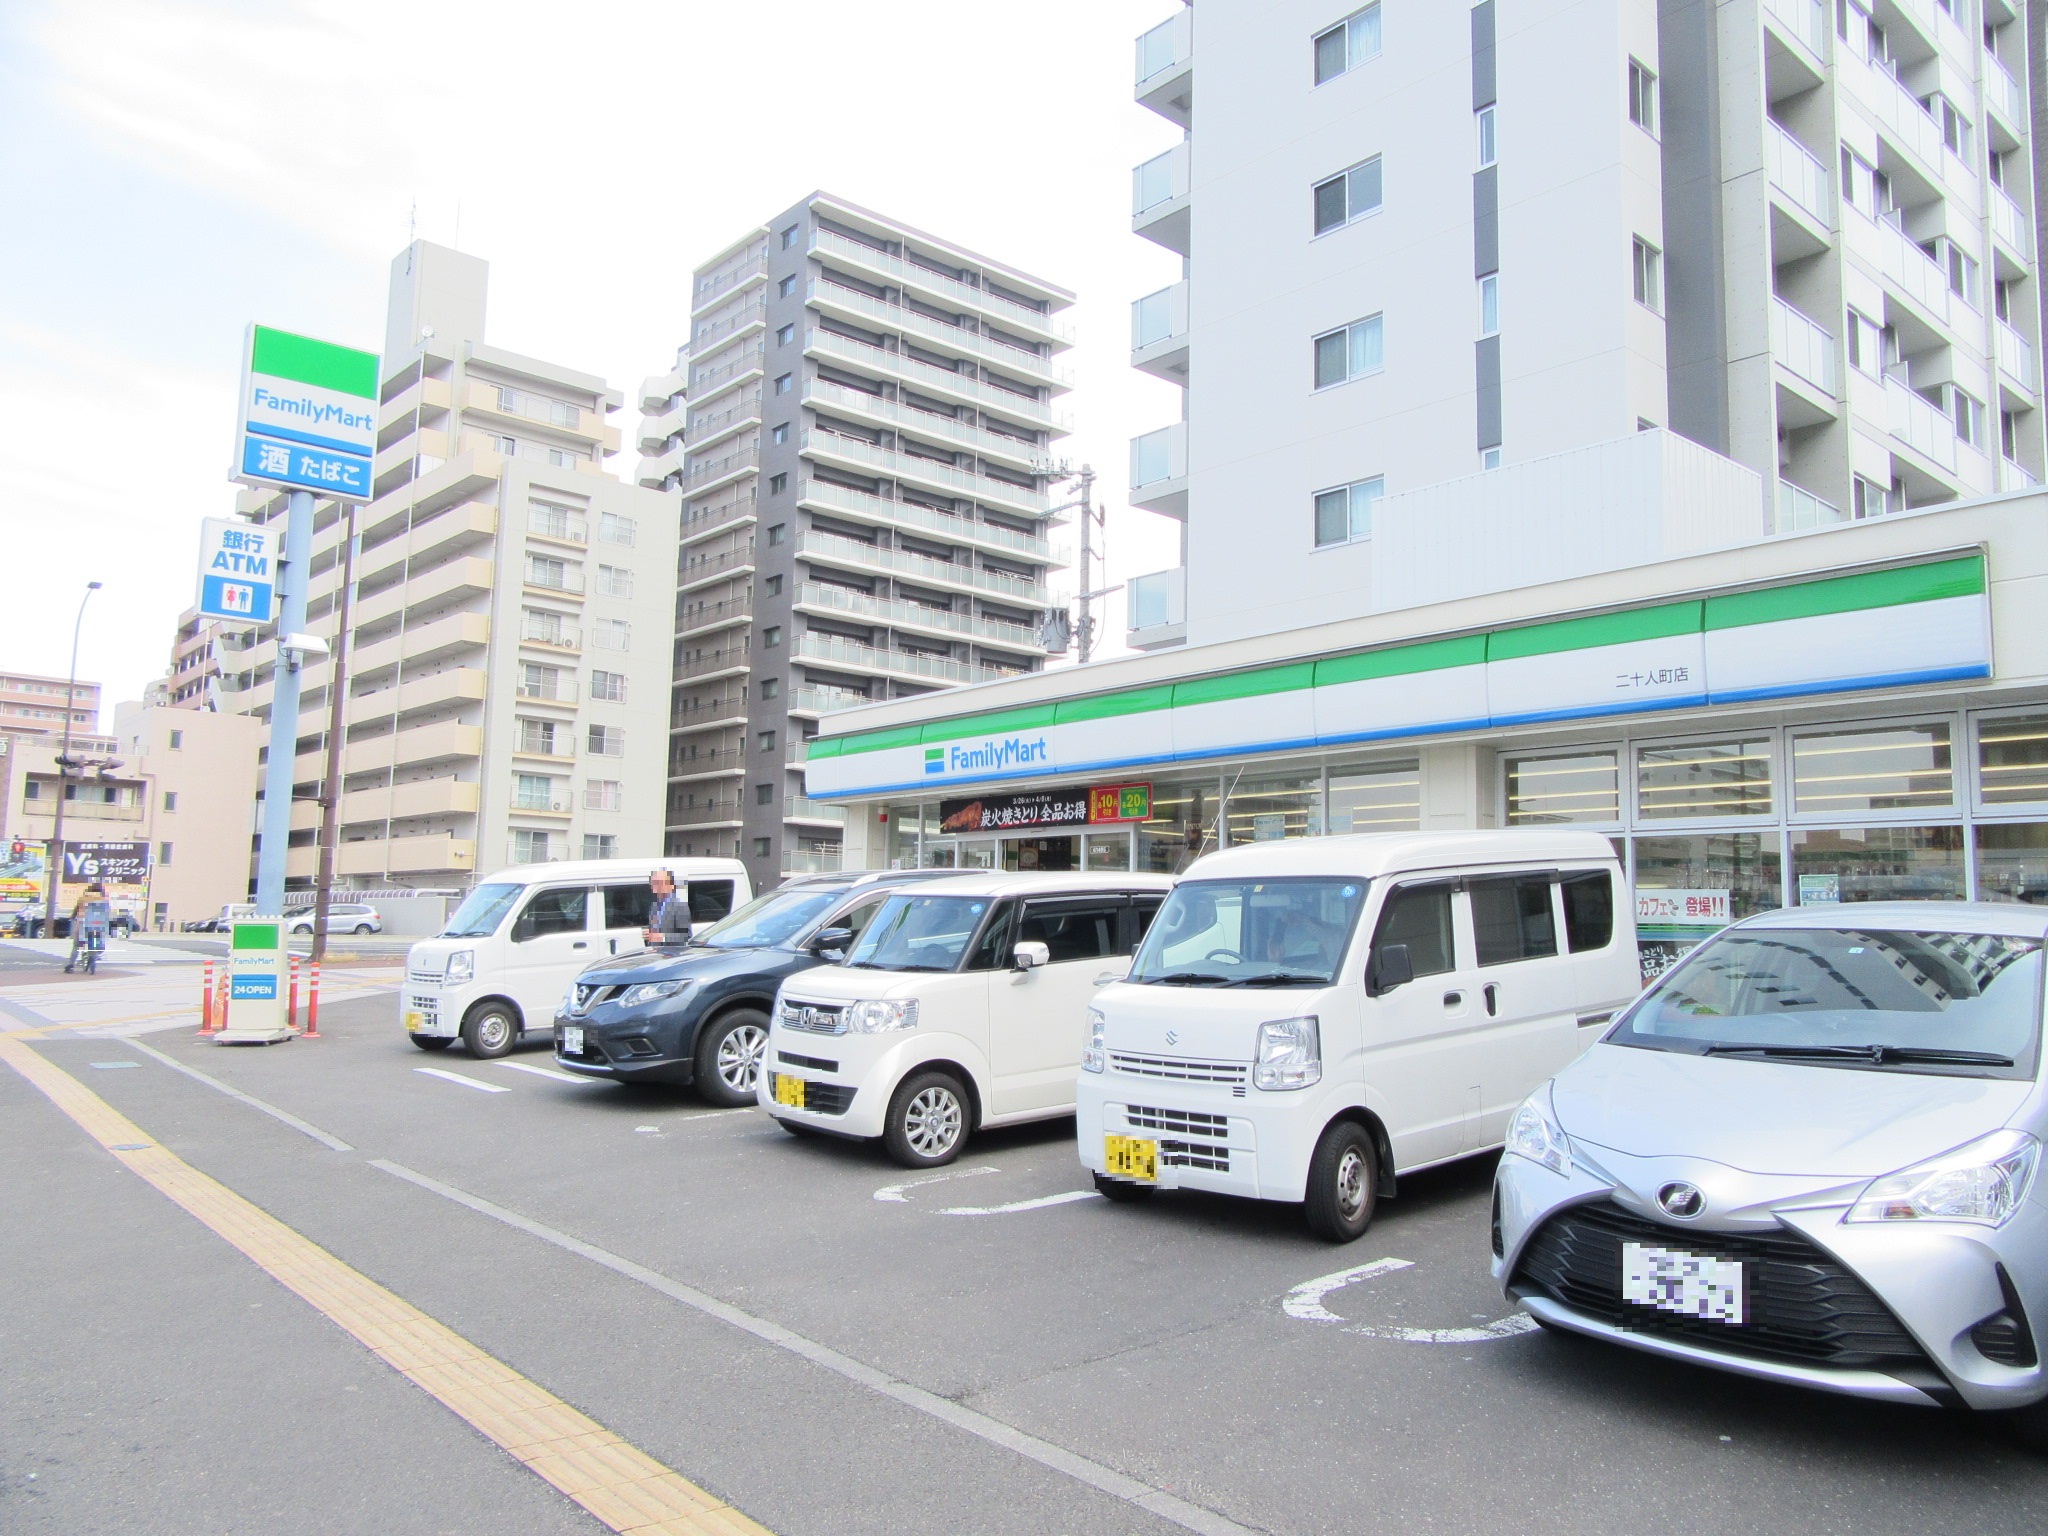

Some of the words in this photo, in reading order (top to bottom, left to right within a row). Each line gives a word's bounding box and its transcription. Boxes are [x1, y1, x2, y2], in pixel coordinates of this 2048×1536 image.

[254, 388, 372, 431] FamilyMart
[259, 444, 290, 476] 酒
[300, 456, 361, 486] たばこ
[222, 529, 265, 554] 銀行
[211, 551, 267, 576] ATM
[1616, 667, 1689, 688] 二十人町店
[951, 736, 1046, 771] FamilyMart
[980, 805, 1038, 827] 炭火焼きとり
[1041, 801, 1087, 822] 全品お得
[66, 852, 99, 875] Y's
[100, 858, 140, 867] スキンケア
[107, 867, 146, 875] クリニック
[1638, 897, 1669, 916] カフェ
[233, 957, 275, 965] FamilyMart
